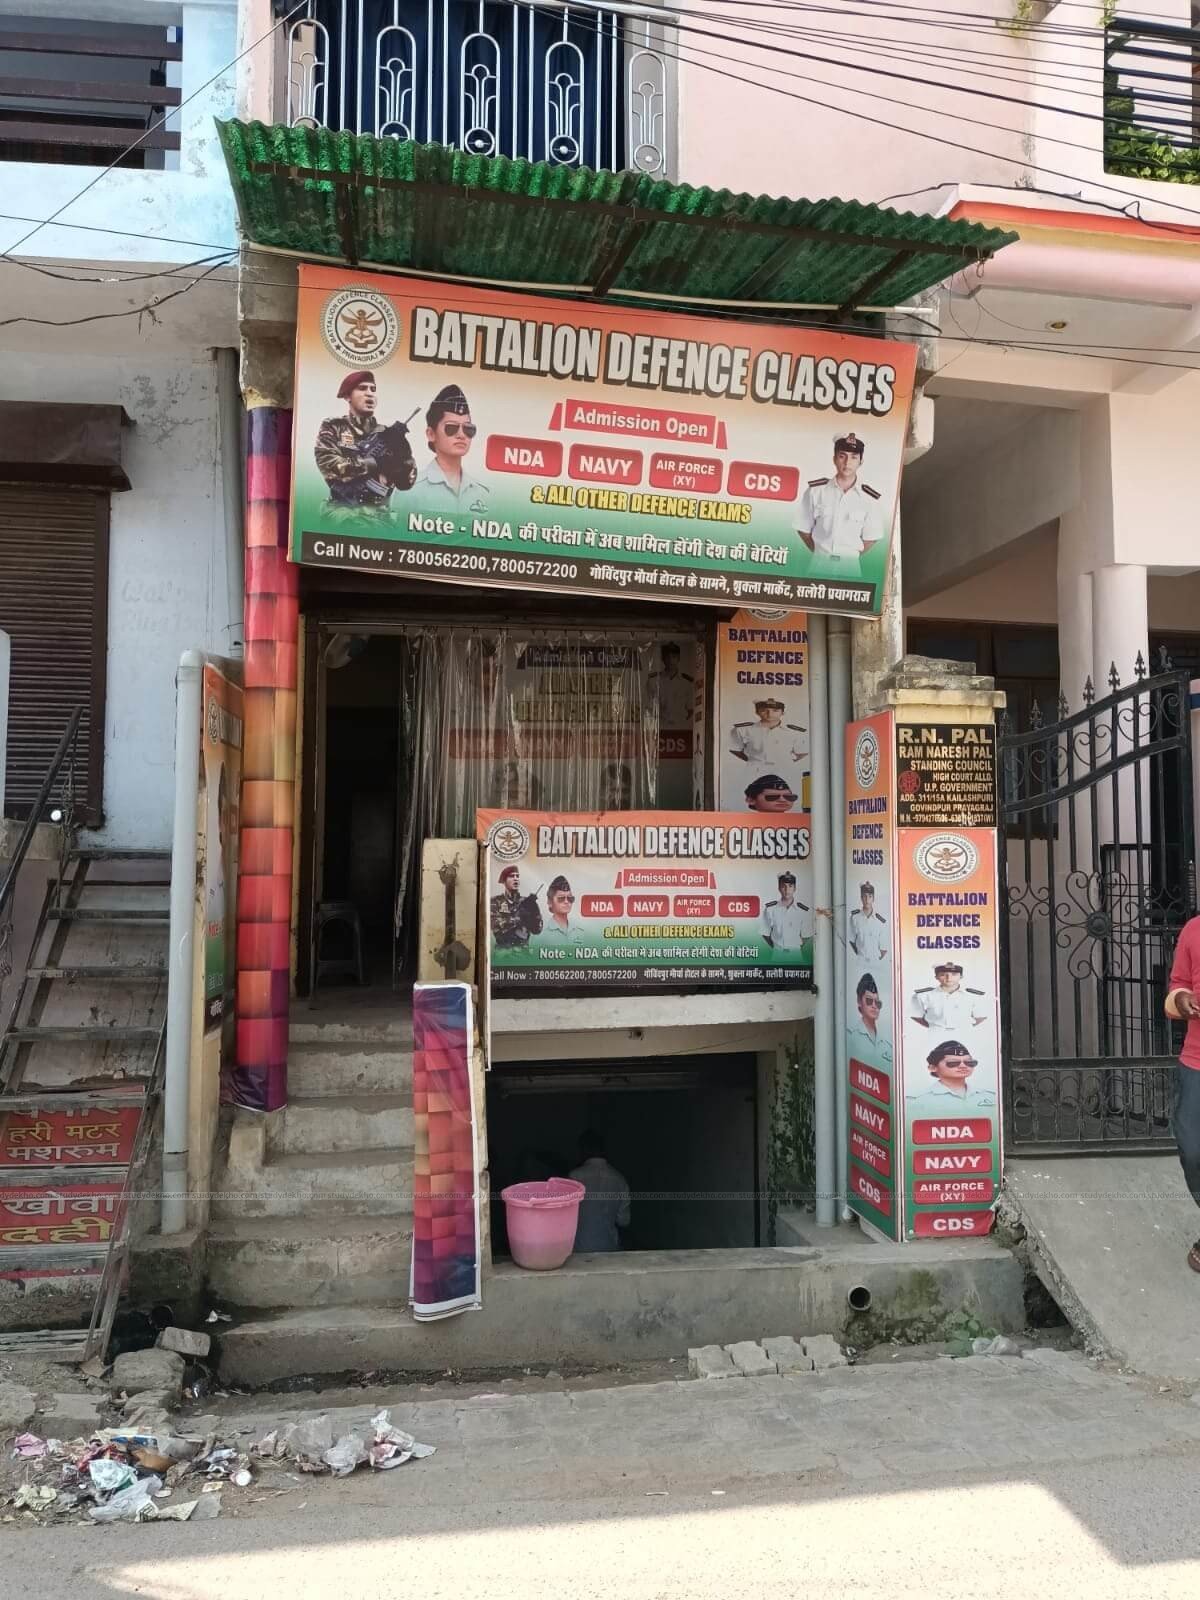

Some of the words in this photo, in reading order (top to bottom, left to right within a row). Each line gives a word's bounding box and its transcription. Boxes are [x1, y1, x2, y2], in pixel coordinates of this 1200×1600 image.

[410, 306, 603, 382] BATTALION
[603, 330, 752, 400] DEFENCE
[752, 350, 896, 417] CLASSES
[573, 406, 661, 432] Admission
[665, 416, 708, 438] Open
[504, 447, 545, 468] NDA
[579, 455, 632, 478] NAVY
[656, 461, 676, 473] AIR
[678, 462, 715, 476] FORCE
[673, 474, 696, 488] (XY)
[744, 473, 782, 493] CDS
[530, 486, 545, 502] &
[547, 485, 574, 506] ALL
[575, 488, 629, 512] OTHER
[631, 493, 697, 518] DEFENCE
[699, 499, 752, 524] EXAMS
[408, 512, 455, 535] Note
[472, 519, 513, 540] NDA
[519, 522, 537, 541] की
[540, 526, 581, 546] परीक्षा
[585, 529, 598, 546] में
[599, 534, 623, 550] अब
[625, 534, 670, 554] शामिल
[705, 541, 727, 560] देश
[729, 543, 747, 562] की
[313, 541, 345, 558] Call
[349, 545, 384, 563] Now
[398, 549, 578, 579] 7800562200,7800572200
[659, 571, 685, 588] होटल
[687, 574, 698, 588] के
[796, 583, 825, 600] सलोरी
[828, 587, 871, 604] प्रयागराज
[737, 650, 803, 664] DEFENCE
[737, 671, 803, 686] CLASSES
[899, 728, 943, 743] R.N.
[951, 728, 992, 743] PAL
[899, 746, 923, 758] RAM
[927, 746, 969, 758] NARESH
[973, 746, 992, 758] PAL
[910, 760, 953, 770] STANDING
[955, 760, 992, 770] COUNCIL
[933, 772, 949, 781] HIGH
[951, 772, 973, 781] COURT
[924, 783, 938, 792] U.P.
[940, 783, 993, 792] GOVERNMENT
[849, 797, 887, 814] BATTALION
[910, 803, 951, 812] GOVINDPUR
[953, 803, 993, 812] PRAYAGRAJ
[853, 824, 883, 839] DEFENCE
[537, 826, 641, 858] BATTALION
[643, 826, 725, 858] DEFENCE
[727, 827, 810, 859] CLASSES
[853, 849, 883, 865] CLASSES
[628, 873, 678, 883] Admission
[680, 873, 705, 885] Open
[907, 893, 987, 906] BATTALION
[590, 902, 614, 912] NDA
[633, 902, 664, 912] NAVY
[728, 902, 751, 913] CDS
[916, 914, 981, 927] DEFENCE
[630, 925, 661, 938] OTHER
[661, 925, 703, 938] DEFENCE
[703, 925, 735, 938] EXAMS
[916, 935, 981, 949] CLASSES
[539, 948, 566, 959] Note
[576, 948, 598, 959] NDA
[602, 946, 612, 958] की
[507, 971, 526, 980] Now
[534, 970, 637, 981] 7800562200,7800572200
[858, 1070, 880, 1094] NDA
[855, 1103, 885, 1131] NAVY
[8, 1121, 53, 1143] हरी
[65, 1122, 122, 1140] मटर
[931, 1126, 973, 1139] NDA
[853, 1134, 863, 1147] AIR
[864, 1141, 886, 1161] FORCE
[925, 1156, 981, 1169] NAVY
[859, 1178, 881, 1204] CDS
[920, 1183, 941, 1191] AIR
[945, 1182, 985, 1191] FORCE
[940, 1192, 966, 1201] (XY)
[0, 1216, 115, 1243] दही
[933, 1218, 975, 1230] CDS
